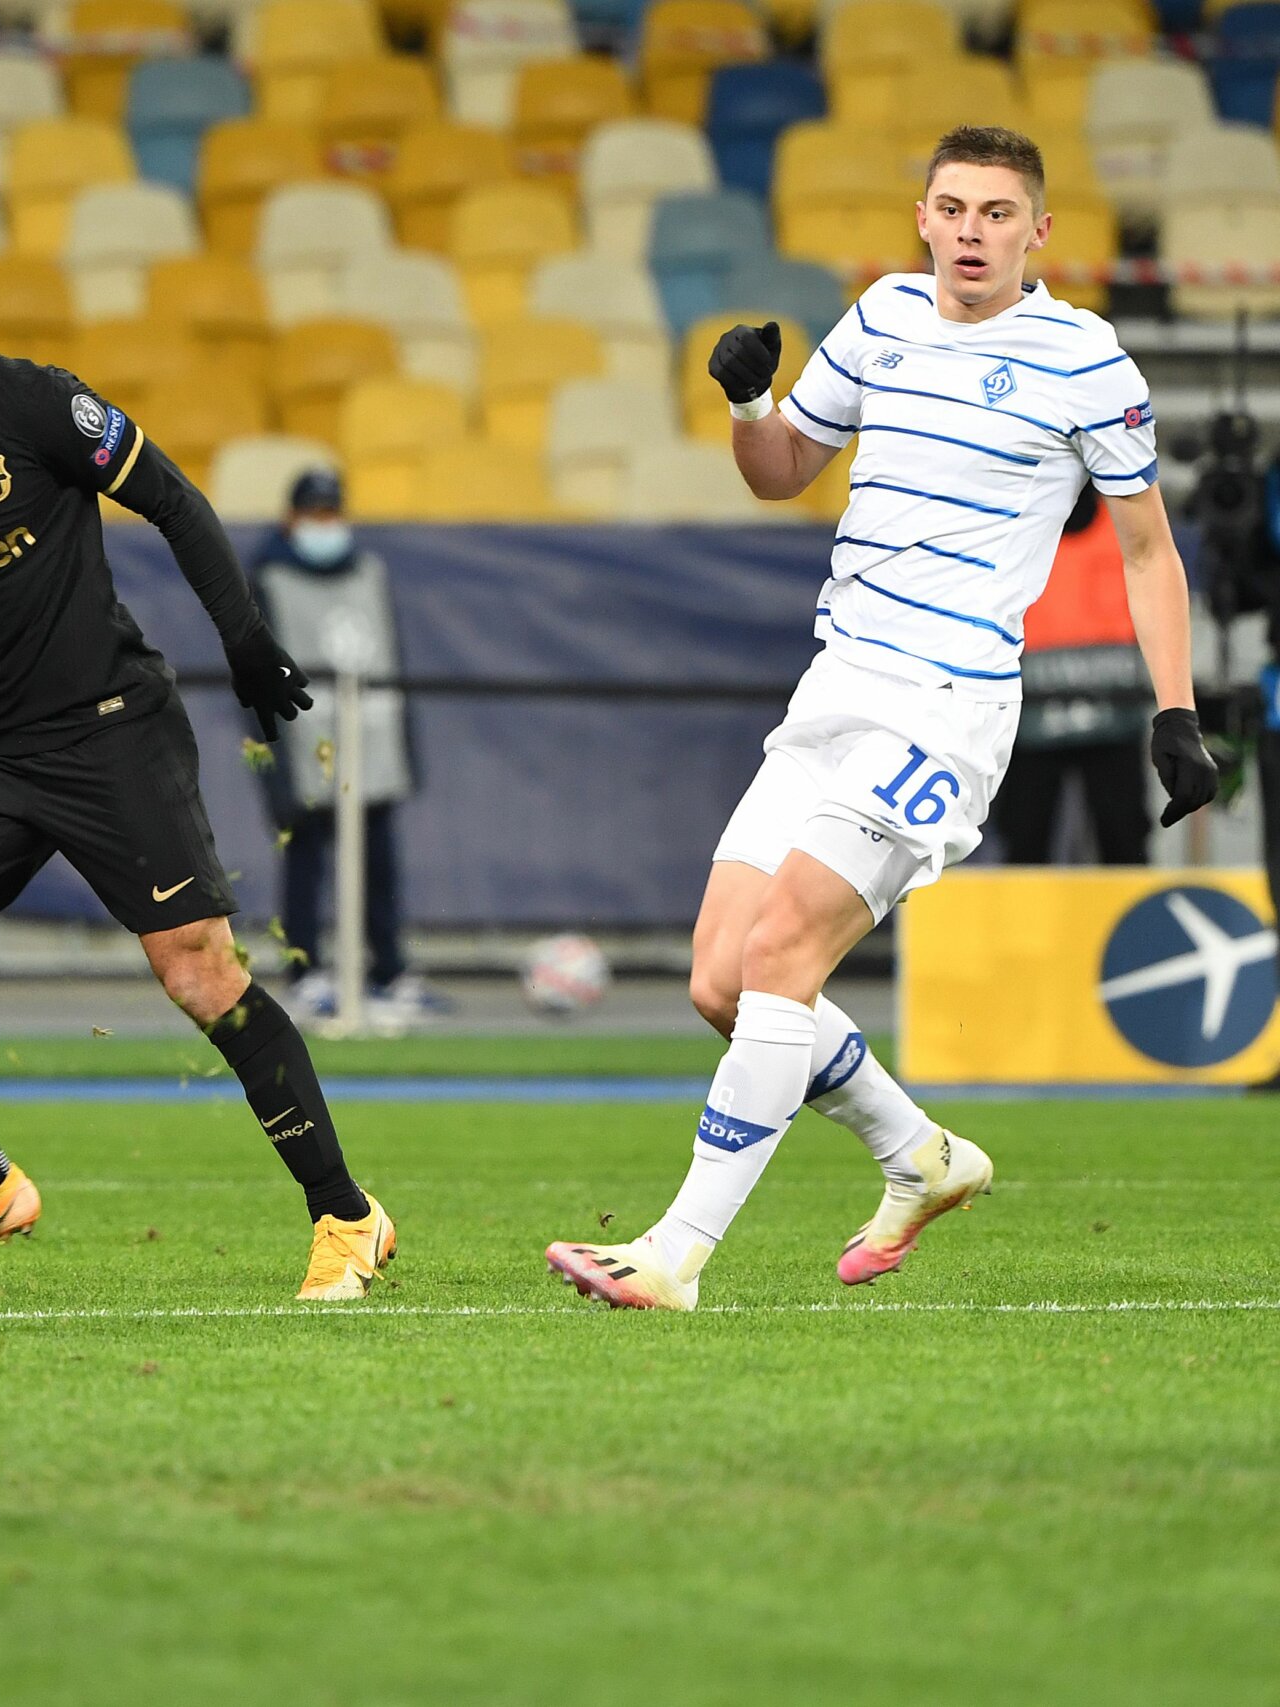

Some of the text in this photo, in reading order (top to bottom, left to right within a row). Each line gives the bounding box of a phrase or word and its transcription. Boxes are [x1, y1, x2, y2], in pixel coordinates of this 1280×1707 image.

[105, 408, 121, 450] RESPECT
[871, 743, 960, 826] 16
[699, 1112, 748, 1145] CDK
